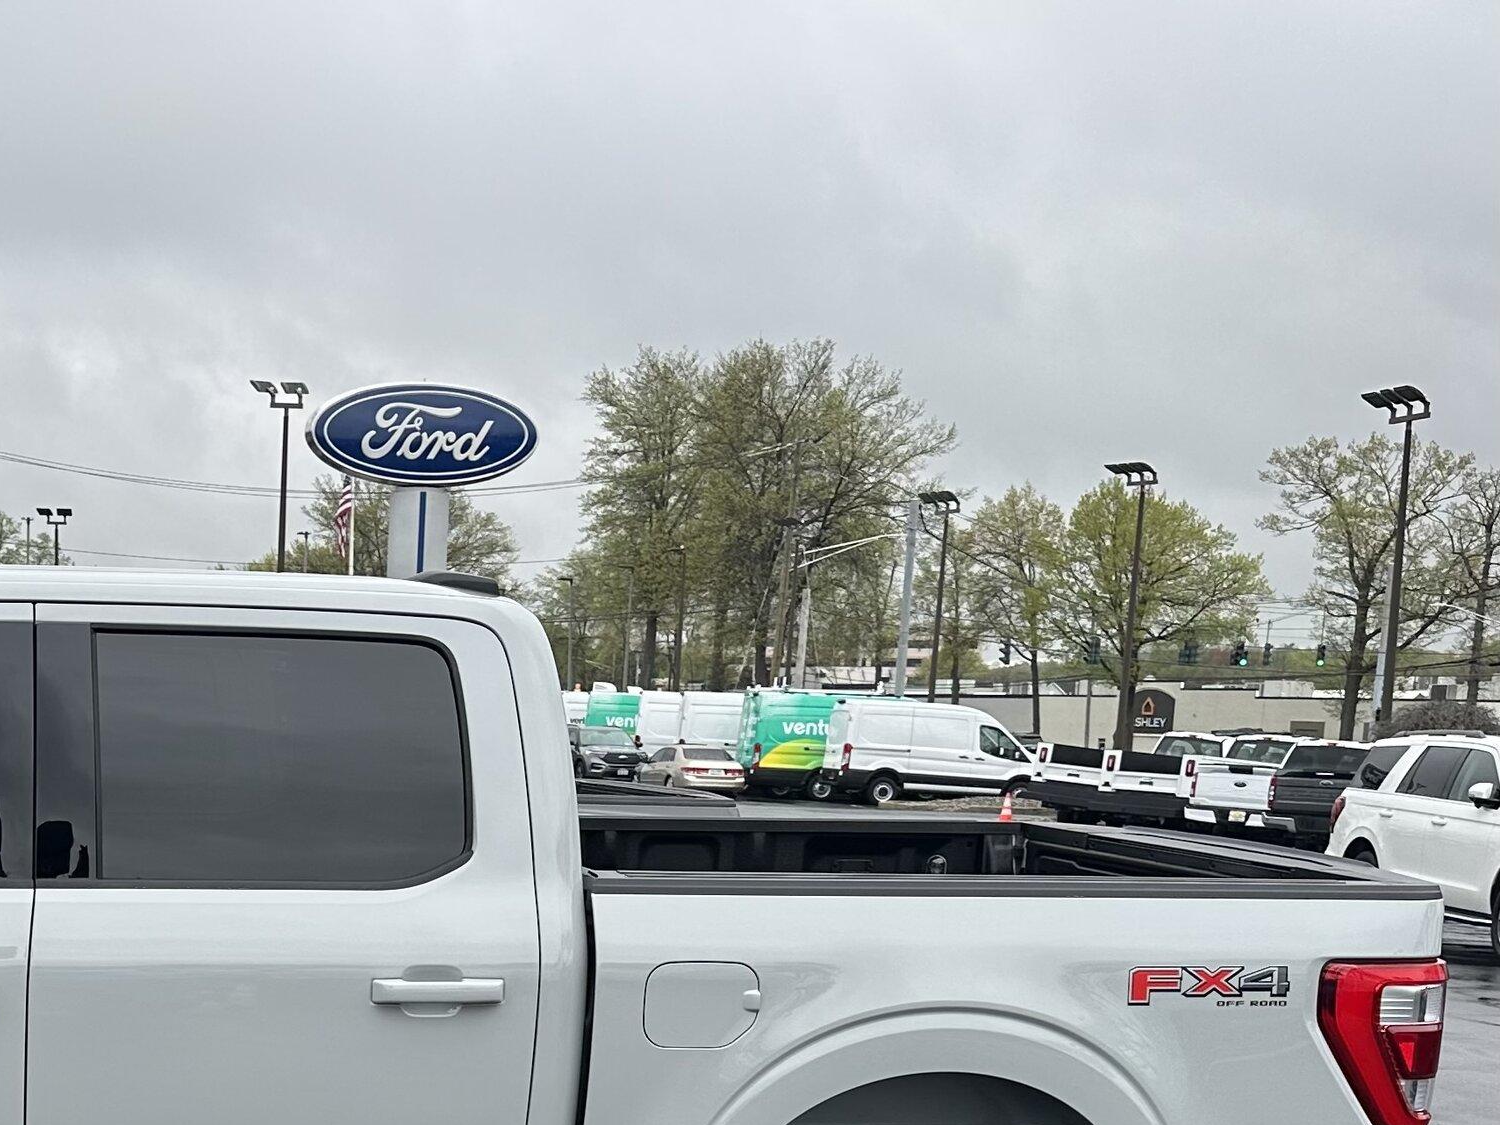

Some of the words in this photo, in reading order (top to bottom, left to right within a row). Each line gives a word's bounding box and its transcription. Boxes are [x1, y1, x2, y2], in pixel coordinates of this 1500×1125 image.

[361, 402, 494, 462] Ford
[1134, 717, 1167, 727] SHLEY
[1128, 965, 1290, 1006] FX4
